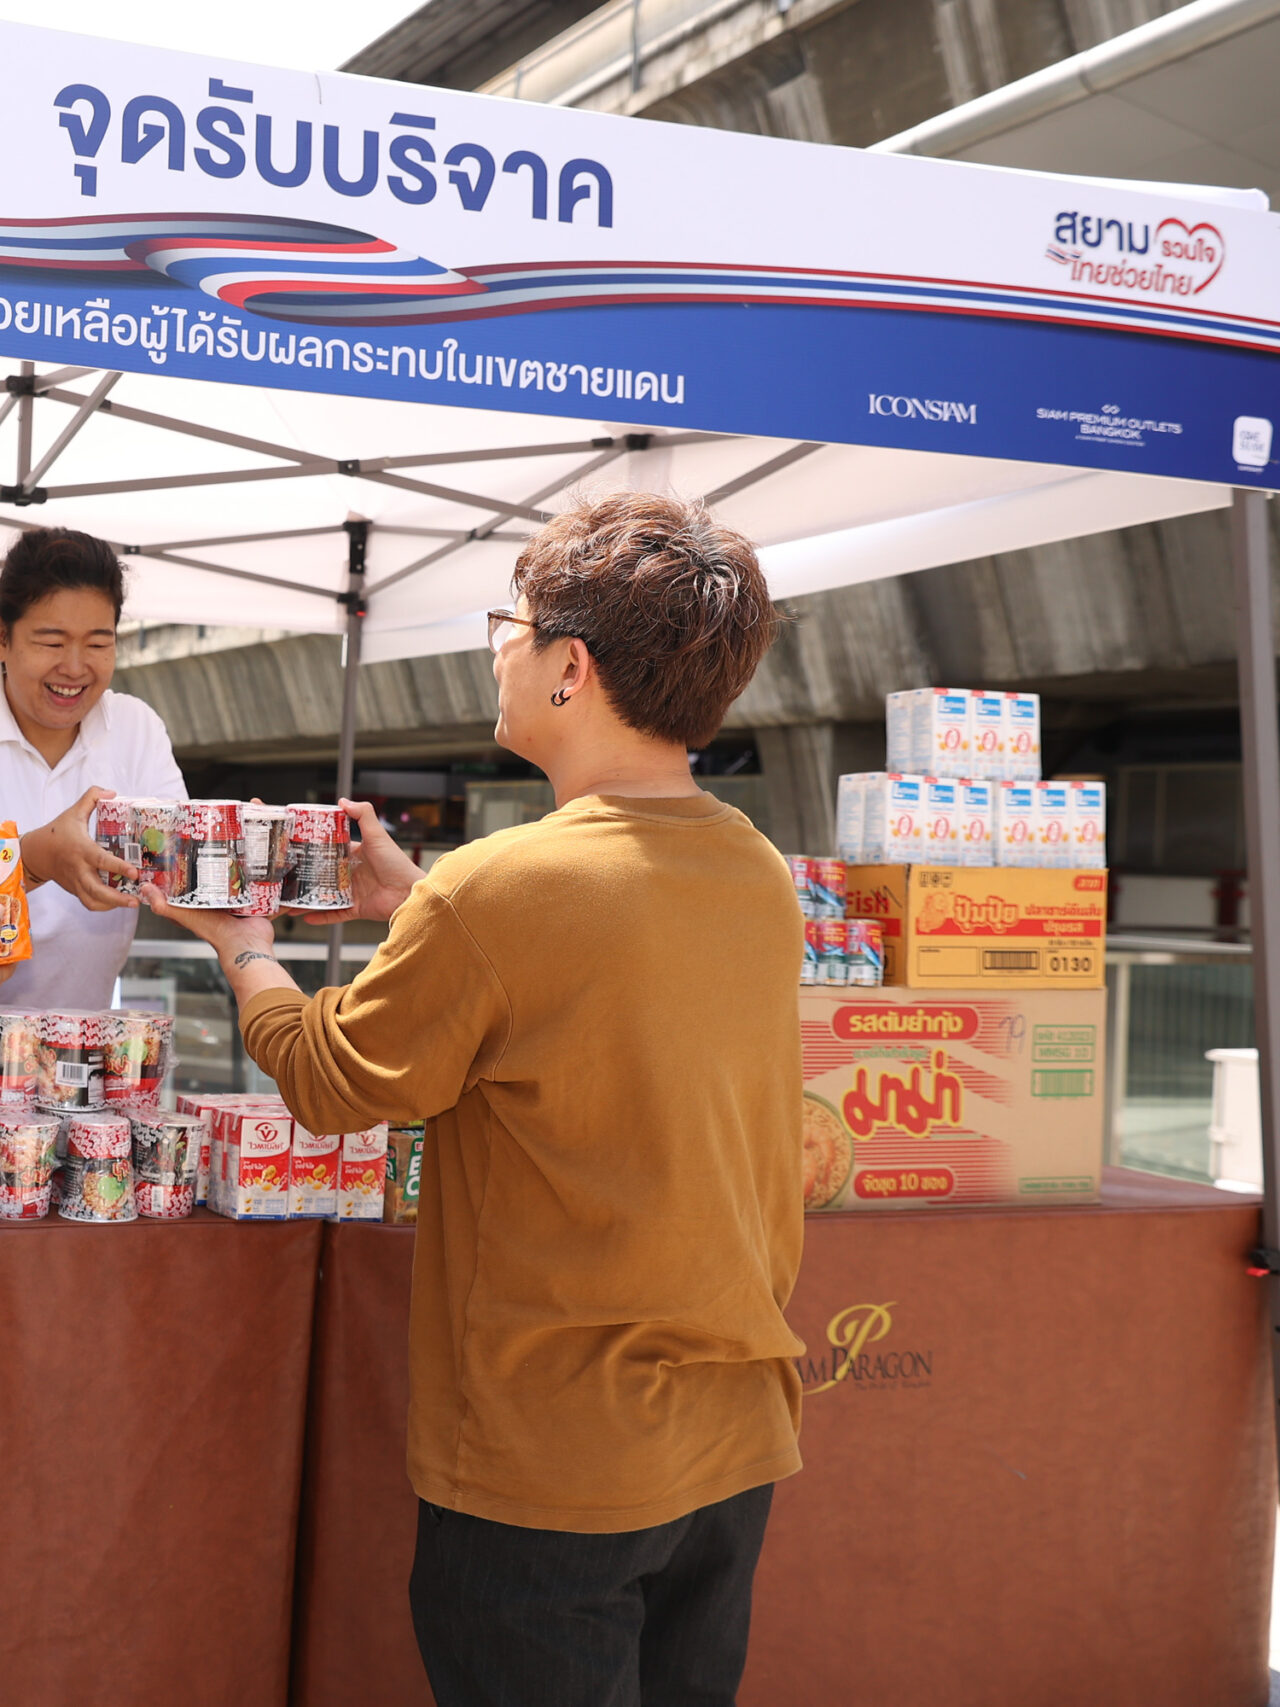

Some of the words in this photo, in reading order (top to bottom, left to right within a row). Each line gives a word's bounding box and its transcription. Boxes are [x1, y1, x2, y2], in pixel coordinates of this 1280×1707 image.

[52, 77, 615, 229] จุดรับบริจาค
[1054, 211, 1149, 255] สยาม
[1161, 235, 1216, 263] รวมใจ
[868, 393, 977, 425] ICONSIAM
[1036, 407, 1068, 422] SIAM
[1068, 411, 1127, 428] PREMIUM
[1127, 418, 1184, 435] OUTLETS
[1079, 423, 1142, 440] BANGKOK
[1049, 956, 1092, 973] 0130
[848, 1008, 964, 1039] รสต้มยำกุ้ง
[841, 1048, 964, 1141] มาม่า
[898, 1172, 919, 1191] 10
